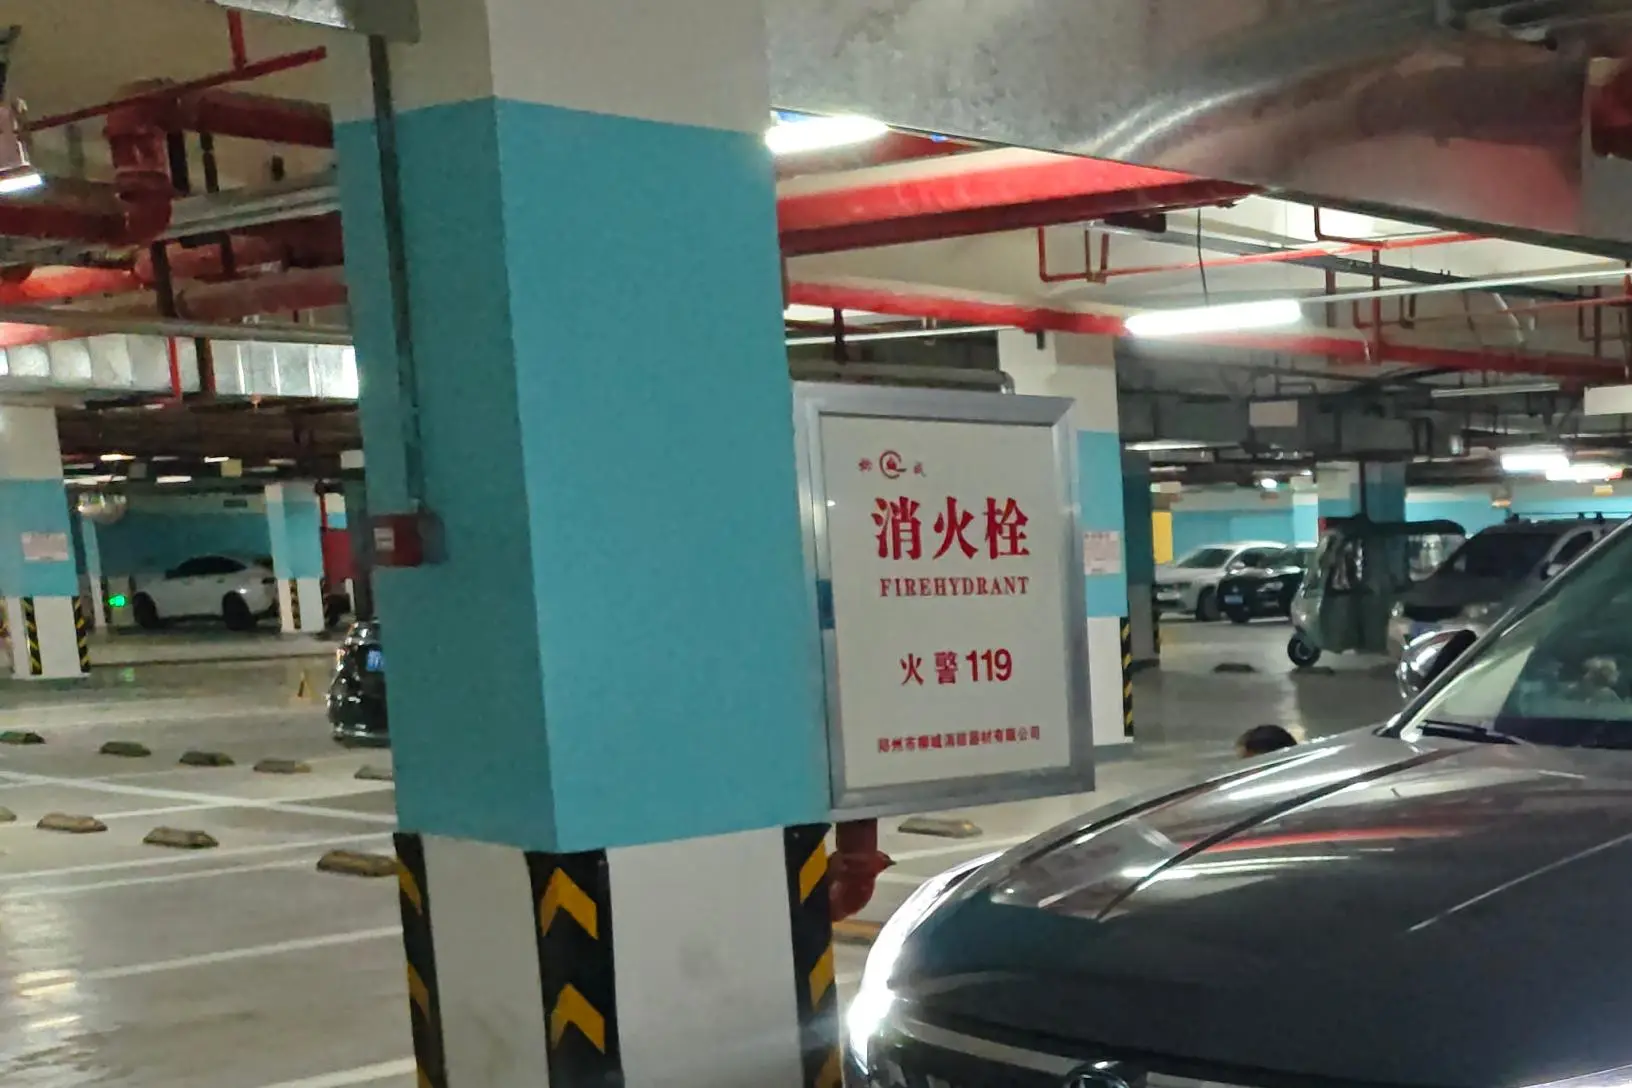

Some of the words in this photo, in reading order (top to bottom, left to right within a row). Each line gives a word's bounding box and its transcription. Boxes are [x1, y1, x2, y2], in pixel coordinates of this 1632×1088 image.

[871, 496, 1030, 560] 消火栓
[879, 575, 1030, 597] FIREHYDRANT
